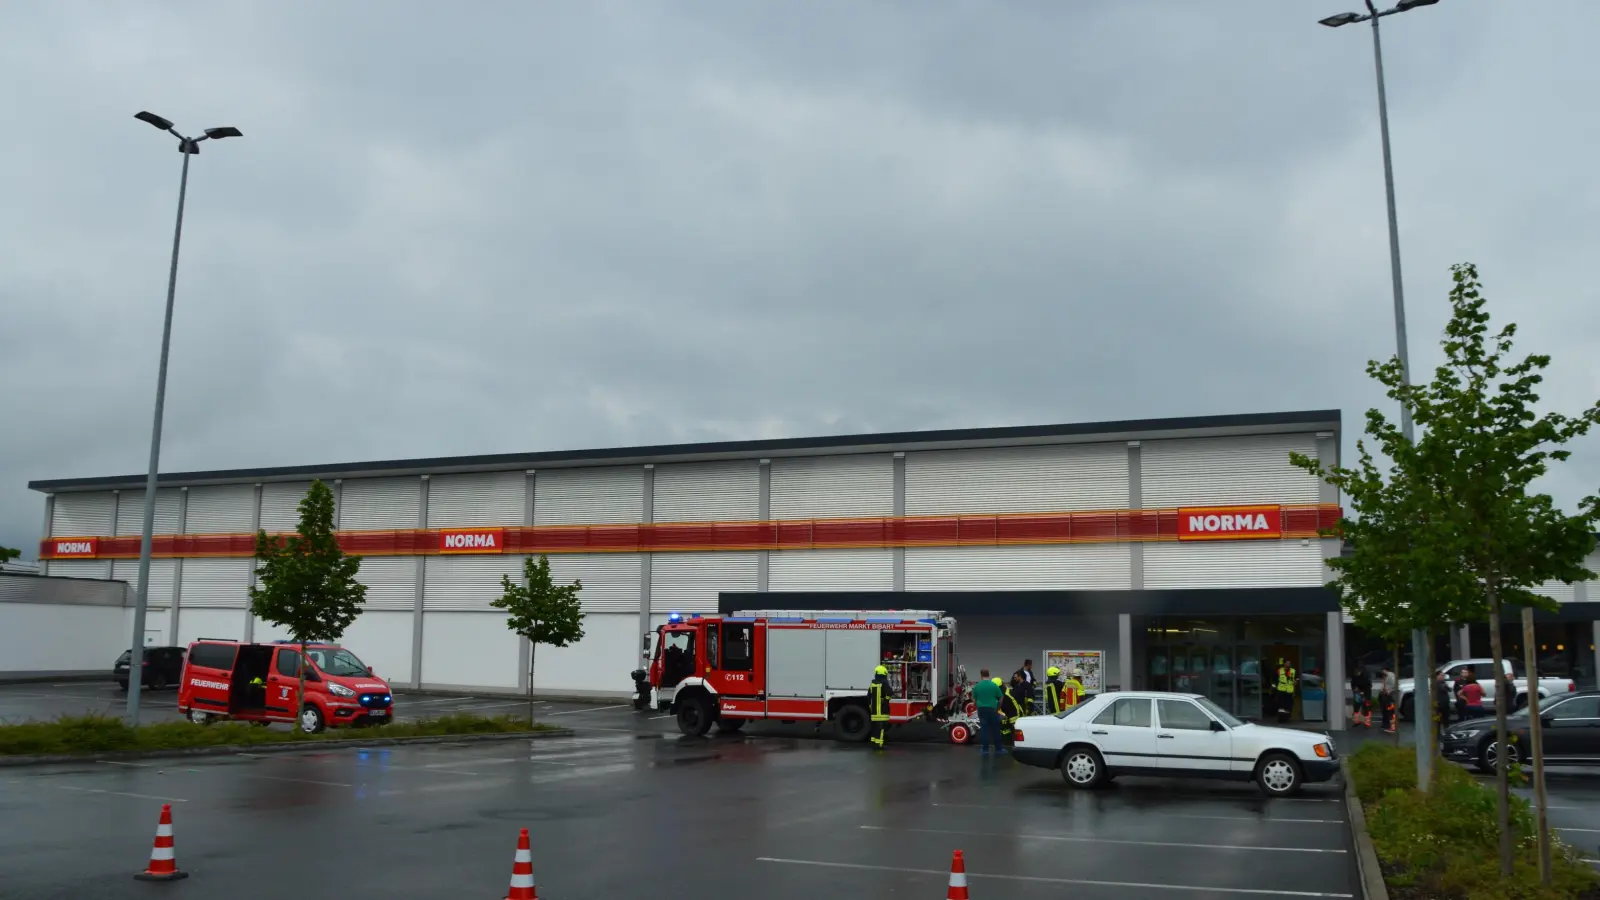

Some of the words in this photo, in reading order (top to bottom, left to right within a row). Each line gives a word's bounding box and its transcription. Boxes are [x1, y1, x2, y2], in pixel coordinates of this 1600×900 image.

[1189, 514, 1269, 531] NORMA
[445, 534, 495, 547] NORMA
[57, 542, 91, 553] NORMA
[191, 678, 229, 690] FEUERWEHR
